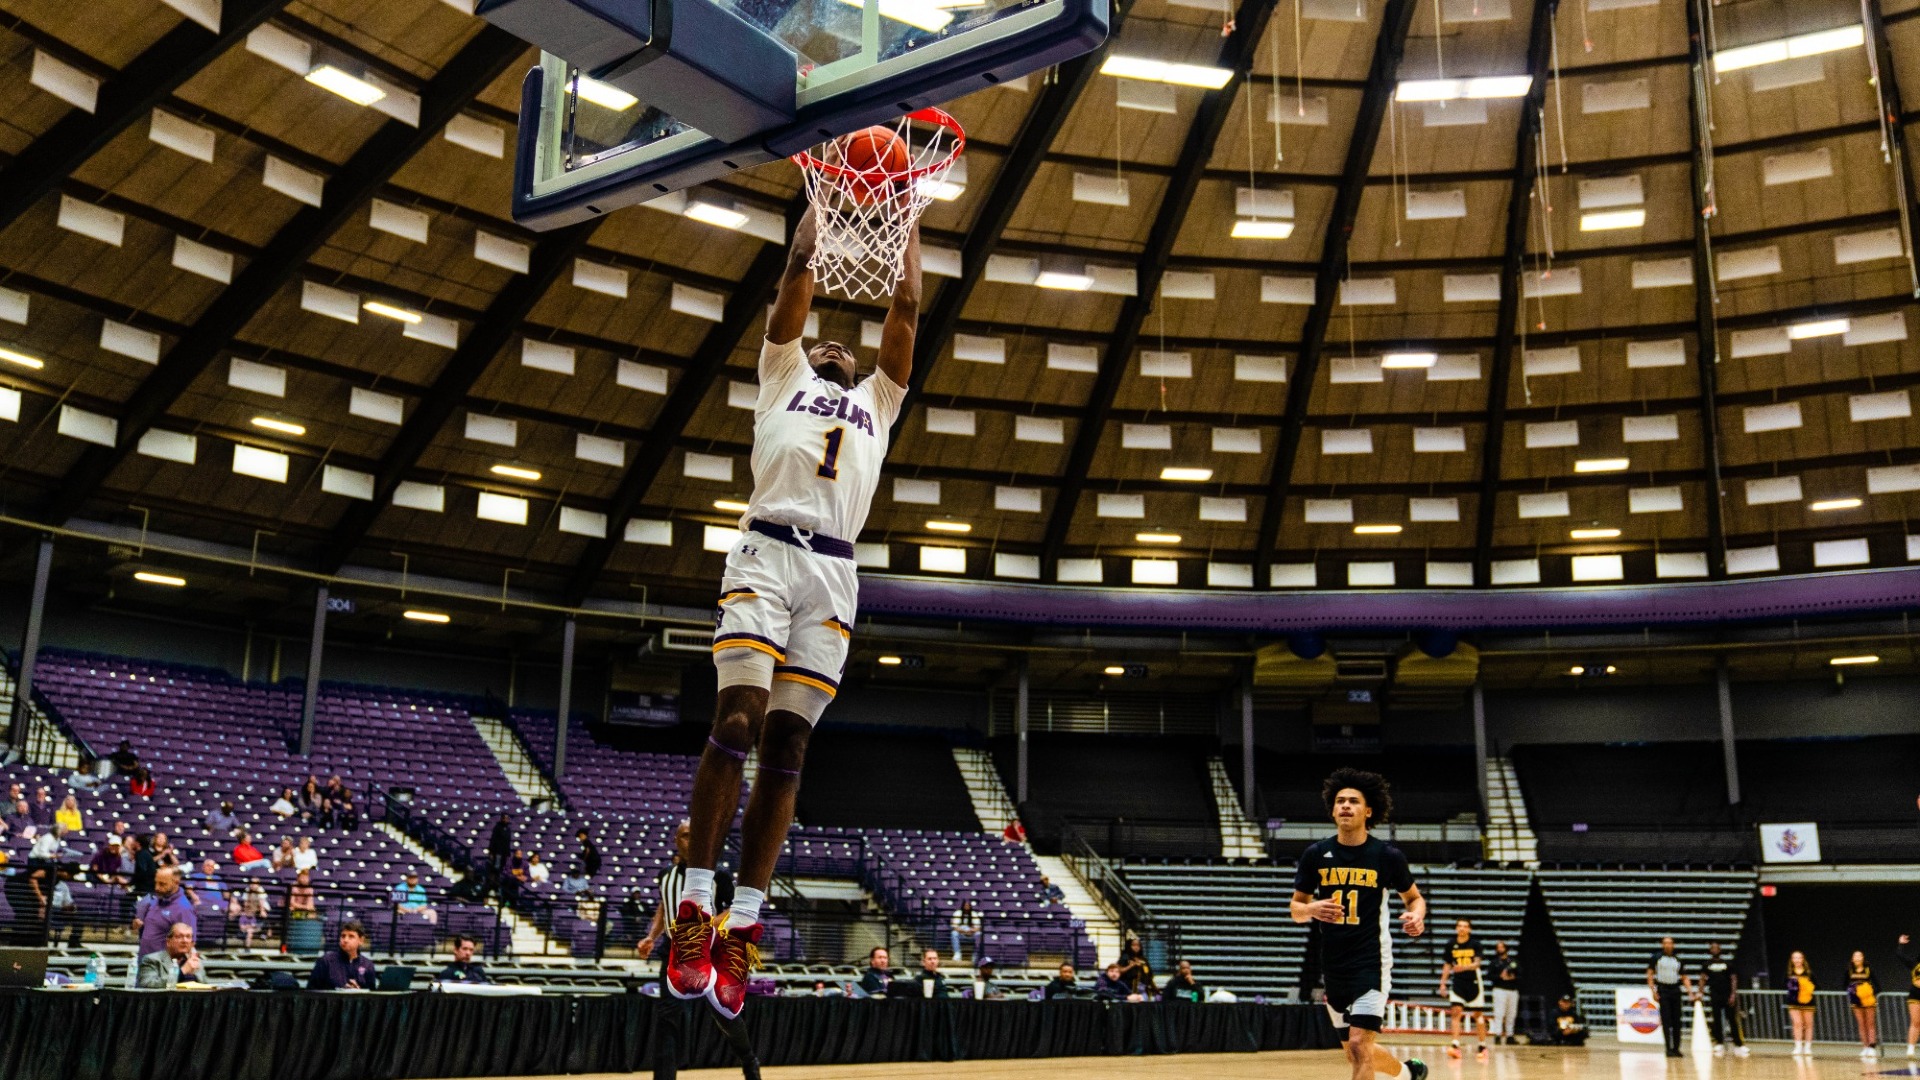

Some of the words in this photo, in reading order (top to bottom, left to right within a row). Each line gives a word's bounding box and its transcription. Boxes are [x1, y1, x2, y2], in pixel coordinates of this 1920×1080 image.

[786, 390, 875, 437] LSUA
[816, 426, 845, 481] 1
[1318, 867, 1378, 888] XAVIER
[1331, 889, 1361, 925] 11
